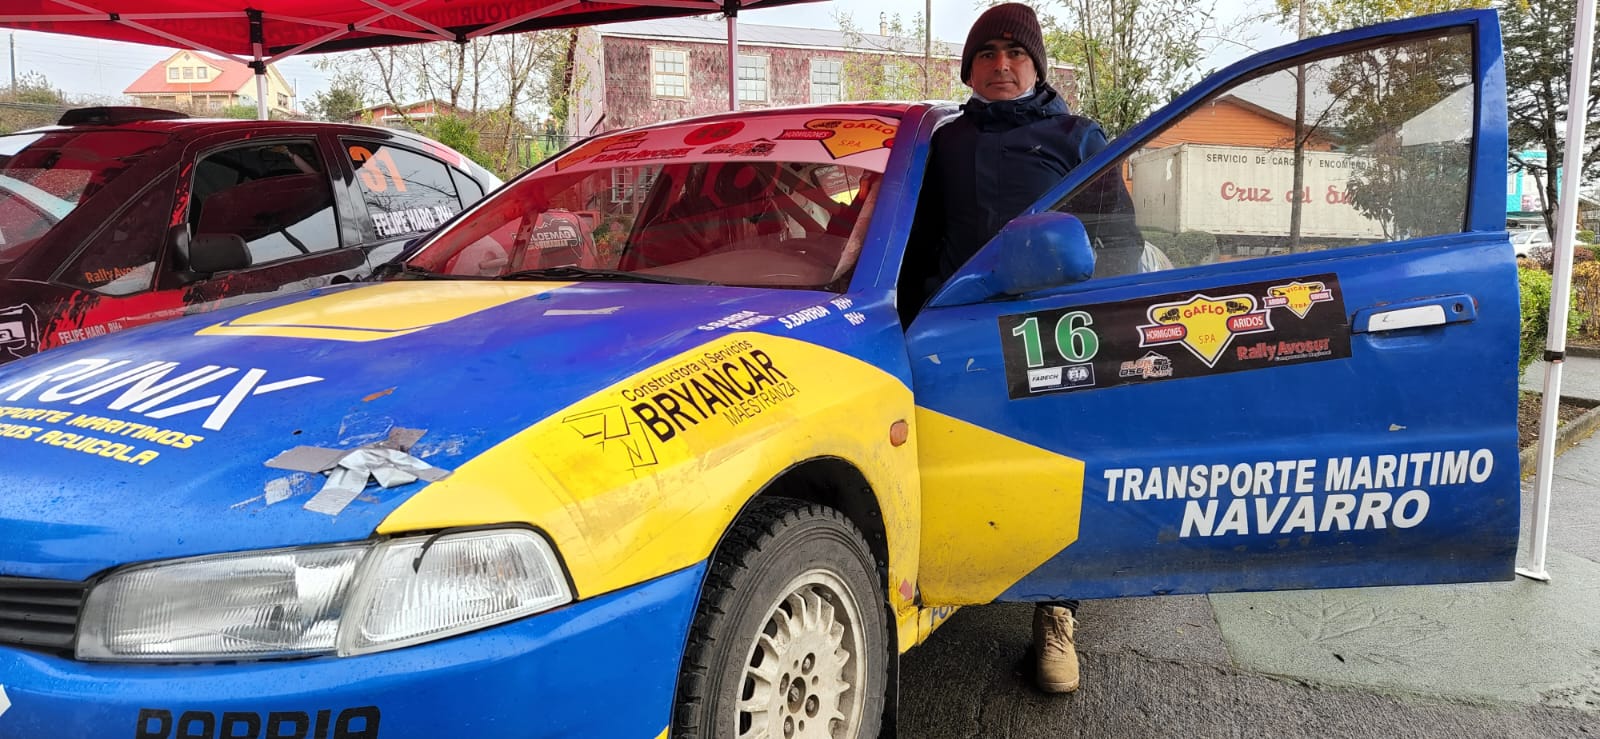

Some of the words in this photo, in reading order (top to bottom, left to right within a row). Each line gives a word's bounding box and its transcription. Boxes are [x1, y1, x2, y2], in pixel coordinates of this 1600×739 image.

[843, 122, 894, 135] GAFLO
[349, 145, 407, 192] 31
[1206, 153, 1248, 163] SERVICIO
[1255, 155, 1266, 164] DE
[1307, 159, 1314, 167] Y
[1220, 181, 1273, 202] Cruz
[372, 210, 411, 237] FELIPE
[406, 207, 437, 231] HARO
[84, 267, 116, 284] Rally
[777, 305, 831, 330] S.BARRIA
[1183, 304, 1225, 318] GAFLO
[1233, 315, 1265, 329] ARIDOS
[58, 328, 86, 345] FELIPE
[85, 324, 107, 340] HARO
[1012, 311, 1099, 368] 16
[1146, 326, 1183, 340] HORMIGONES
[1236, 342, 1277, 361] Rally
[1277, 338, 1330, 356] Avosur
[621, 362, 701, 402] Constructora
[697, 358, 711, 371] y
[704, 340, 753, 364] Servicios
[630, 349, 788, 443] BRYANCAR
[722, 380, 801, 427] MAESTRANZA
[65, 414, 204, 450] MARITIMOS
[33, 430, 160, 466] ACUICOLA
[1103, 458, 1317, 502] TRANSPORTE
[1324, 448, 1495, 492] MARITIMO
[1179, 489, 1431, 538] NAVARRO
